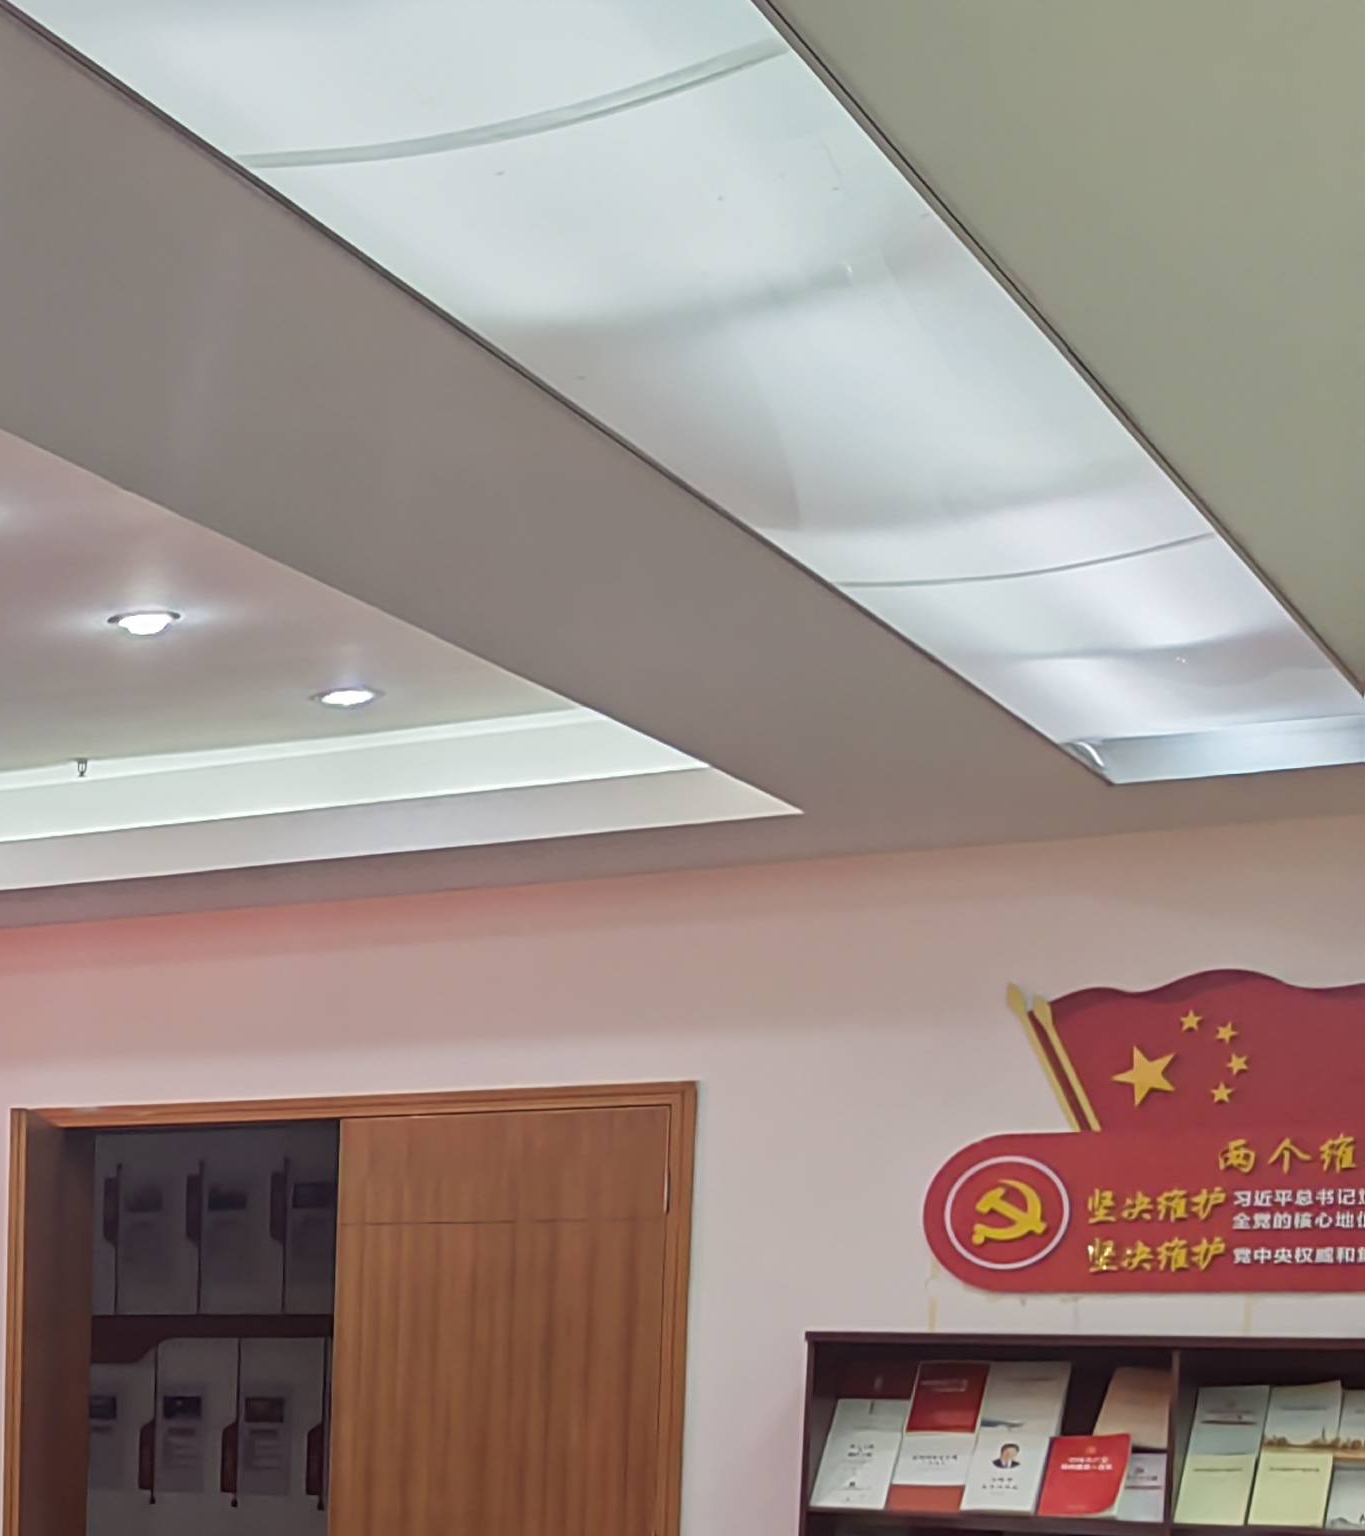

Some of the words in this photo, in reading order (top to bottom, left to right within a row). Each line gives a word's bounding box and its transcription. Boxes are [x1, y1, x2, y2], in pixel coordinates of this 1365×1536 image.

[1087, 1187, 1227, 1226] 坚决维护
[1087, 1236, 1226, 1274] 坚决维护
